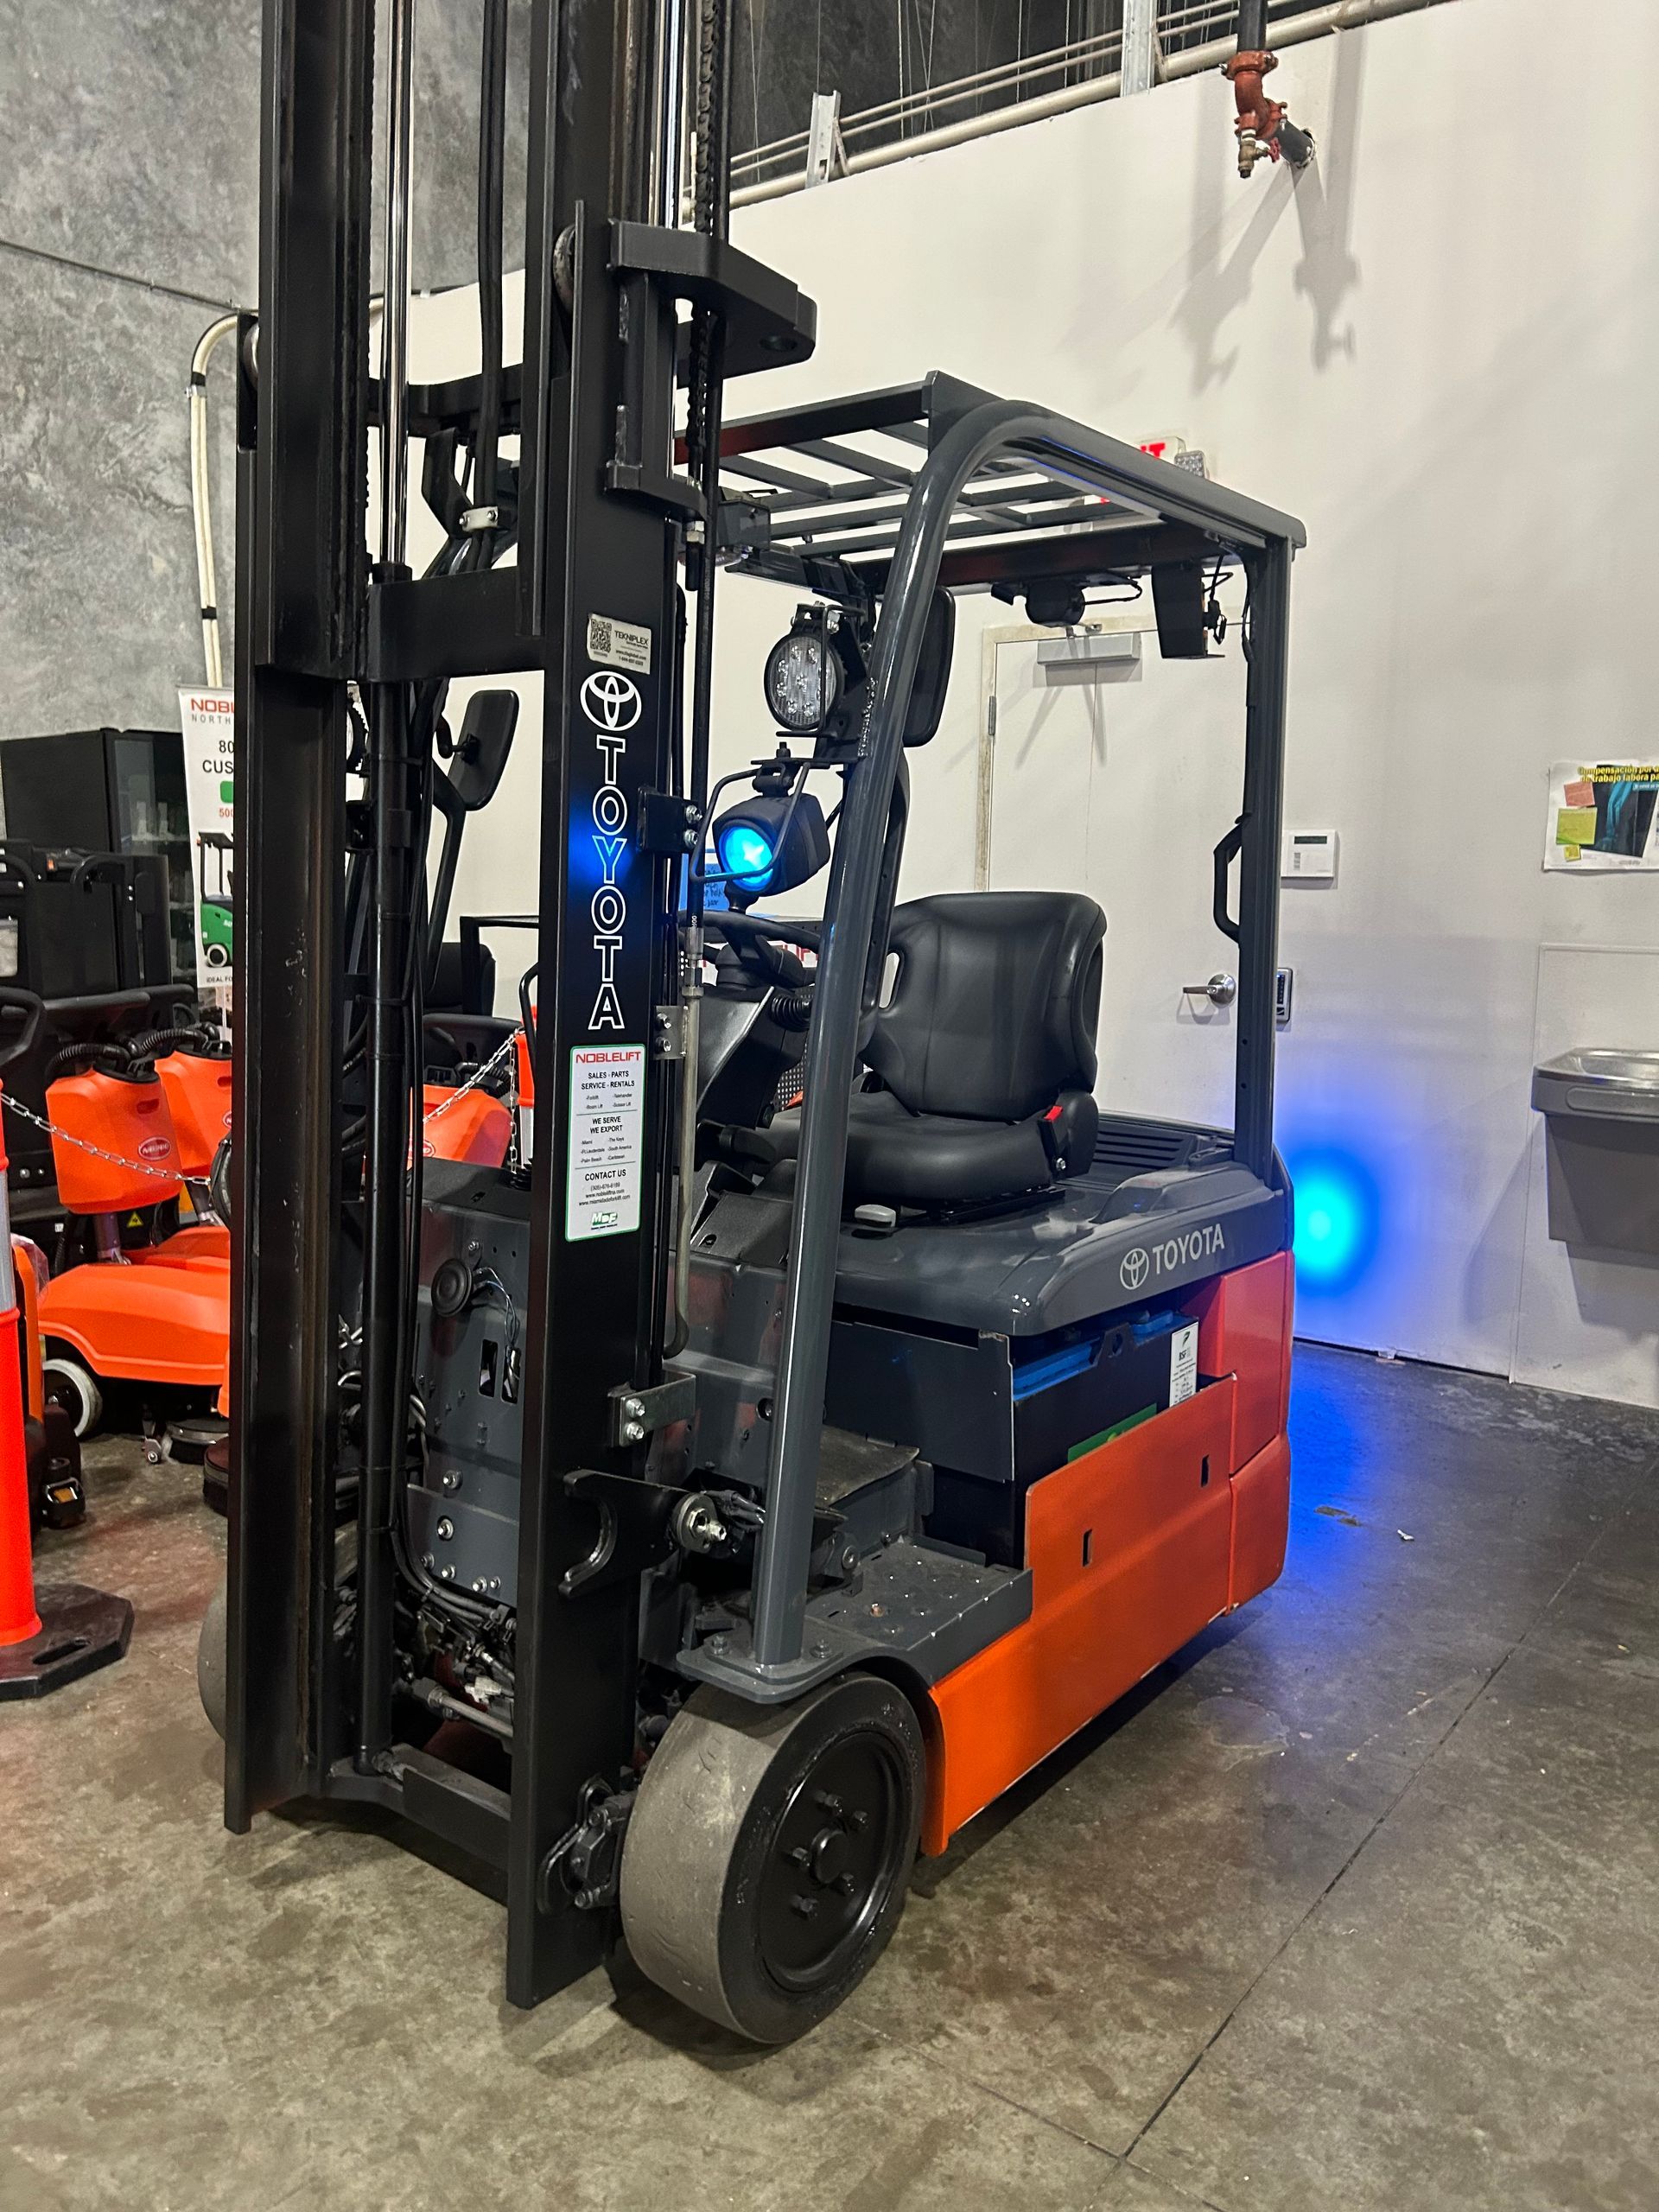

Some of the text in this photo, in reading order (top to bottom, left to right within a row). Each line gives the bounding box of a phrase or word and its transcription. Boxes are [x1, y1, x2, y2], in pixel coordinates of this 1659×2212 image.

[614, 631, 648, 646] TEKNIPLEX
[191, 714, 232, 725] NORTH
[588, 735, 626, 1030] TOYOTA
[575, 1051, 641, 1063] NOBLELIFT
[581, 1082, 606, 1090] SERVICE
[610, 1080, 635, 1089] RENTALS
[601, 1125, 623, 1134] EXPORT
[585, 1171, 616, 1180] CONTACT
[592, 1212, 617, 1224] MDF
[1153, 1224, 1224, 1274] TOYOTA
